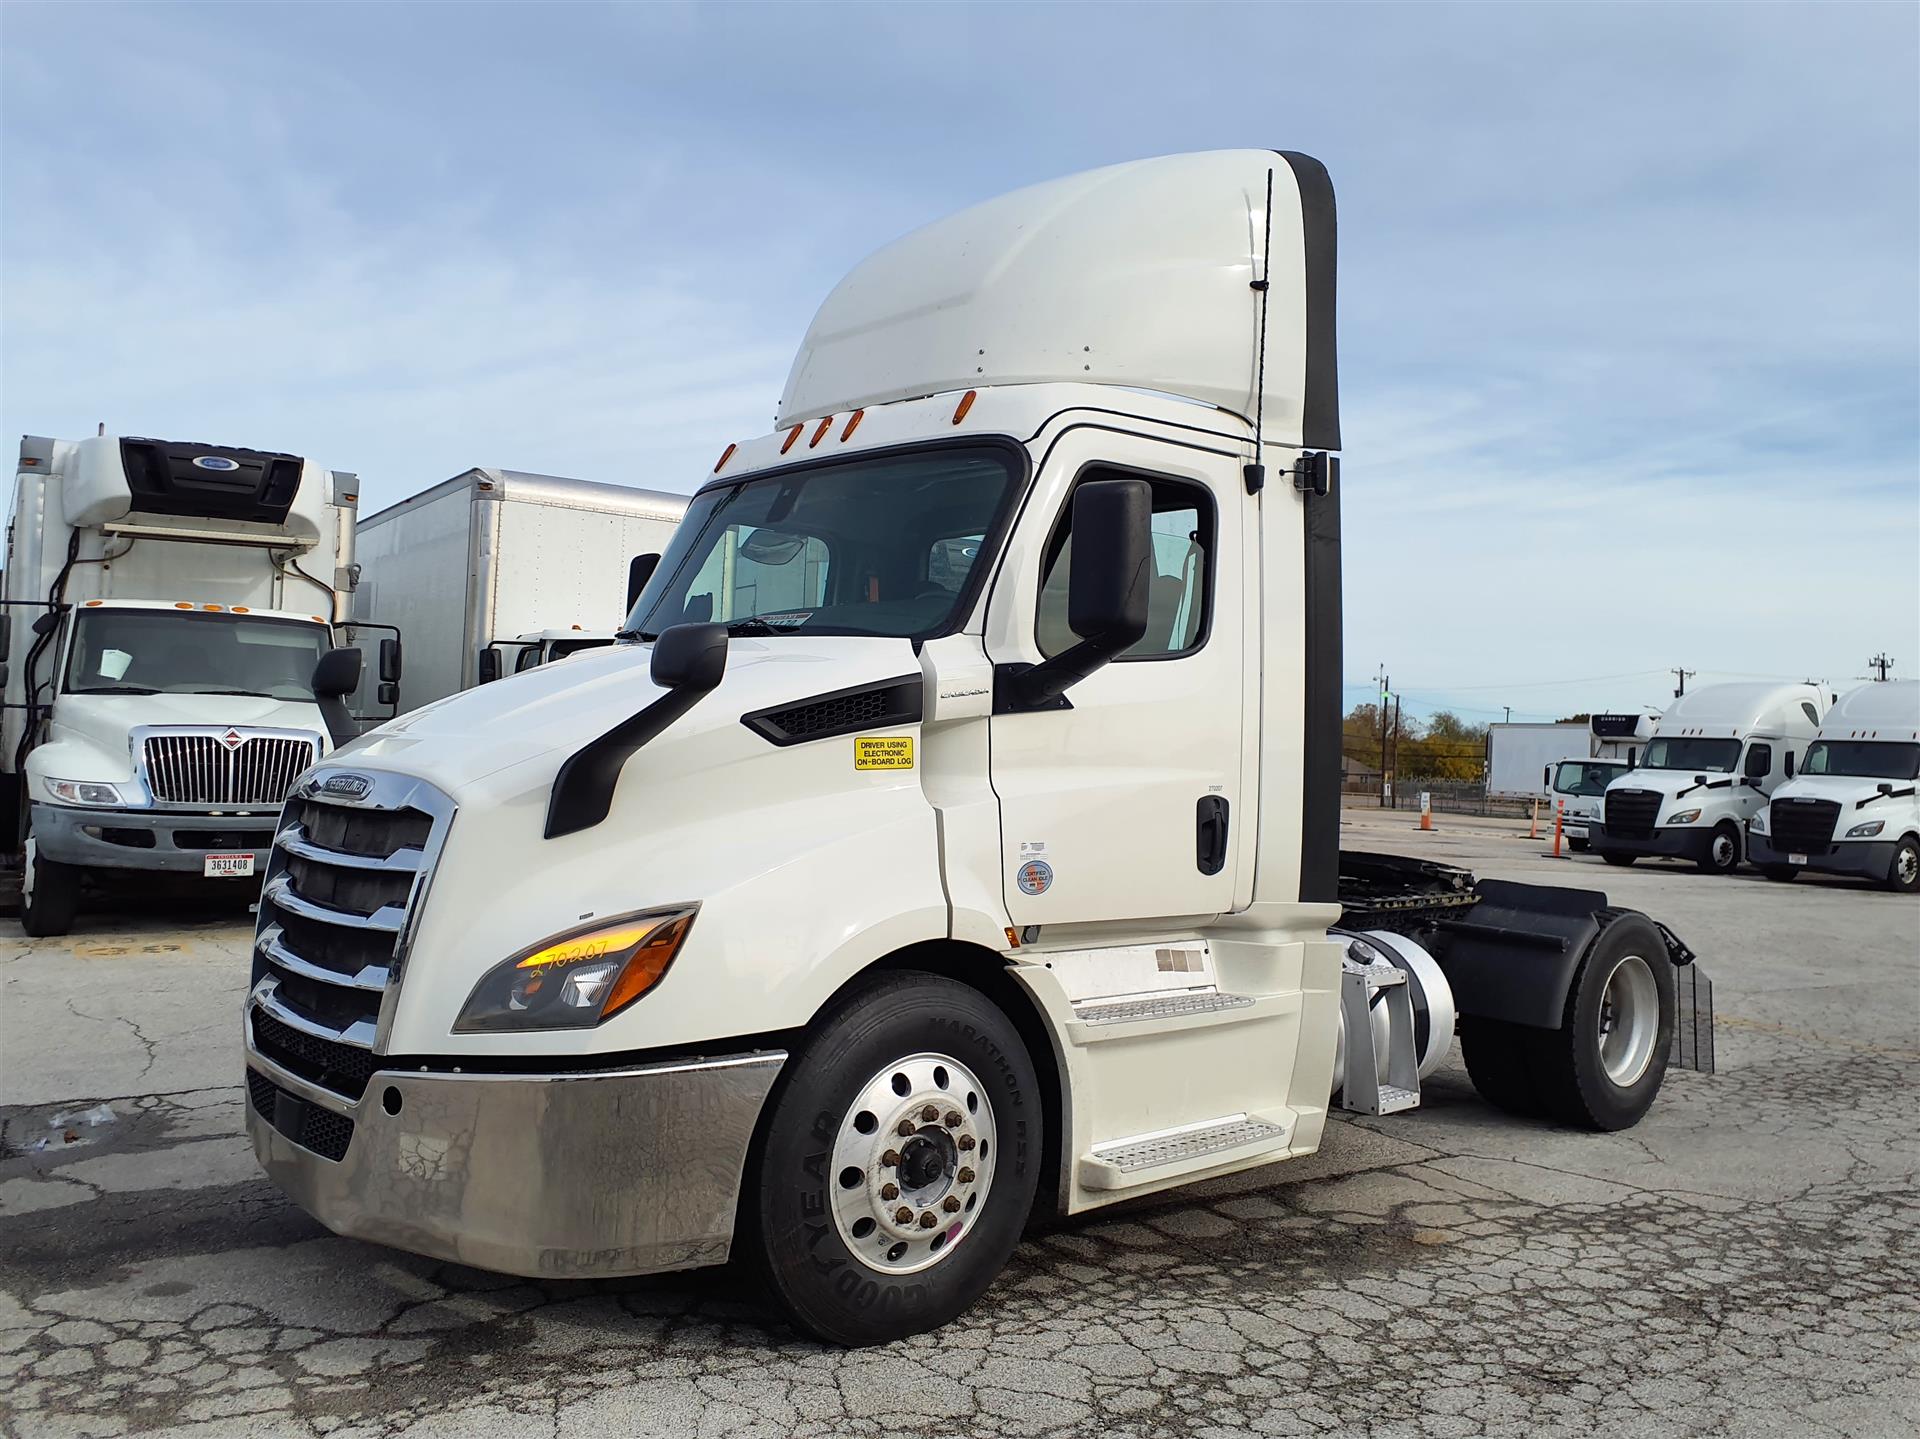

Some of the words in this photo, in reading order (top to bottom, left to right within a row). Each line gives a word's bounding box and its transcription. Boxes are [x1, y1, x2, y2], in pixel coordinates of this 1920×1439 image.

[857, 758, 896, 766] ON-BOARD
[897, 757, 911, 765] LOG
[211, 859, 248, 870] 3631408
[529, 940, 609, 979] 270207
[929, 1016, 1024, 1107] MARATHON
[801, 1110, 929, 1311] GOODYEAR
